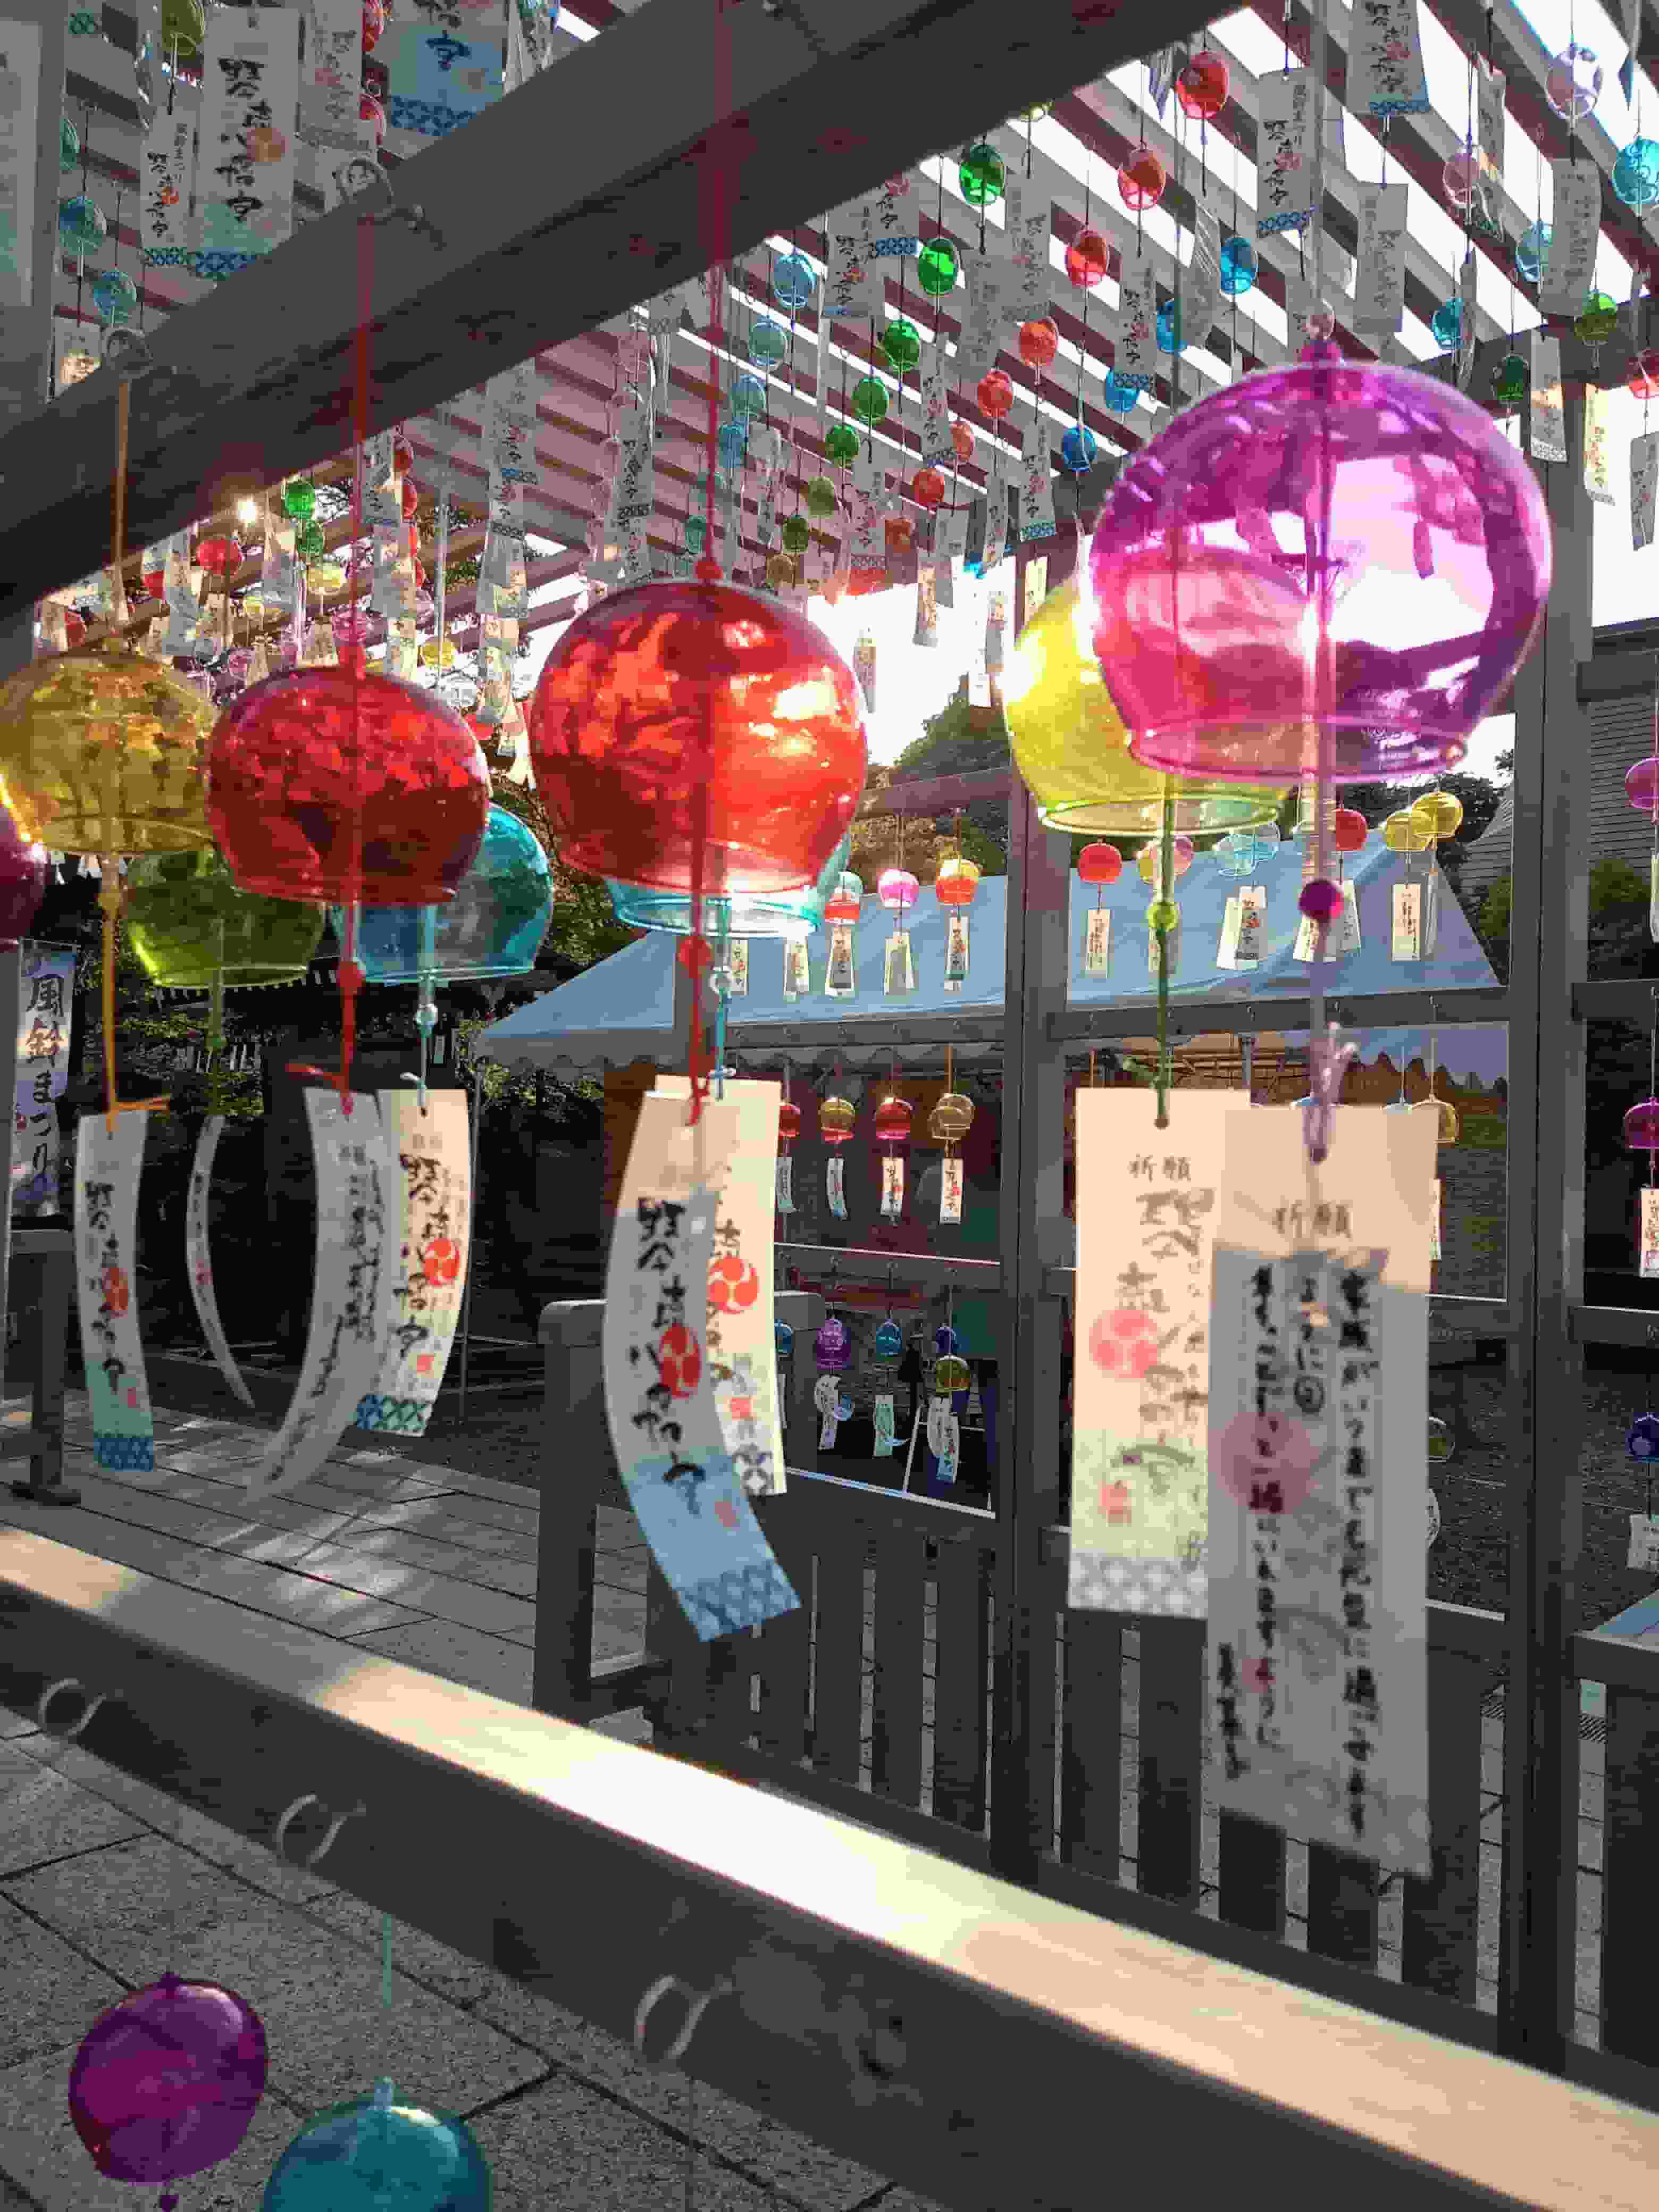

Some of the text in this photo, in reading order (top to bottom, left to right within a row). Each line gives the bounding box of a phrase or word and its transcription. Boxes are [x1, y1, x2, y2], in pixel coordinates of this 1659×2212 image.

[26, 976, 65, 1175] 風鈴まつり
[1128, 1154, 1192, 1182] 祈願
